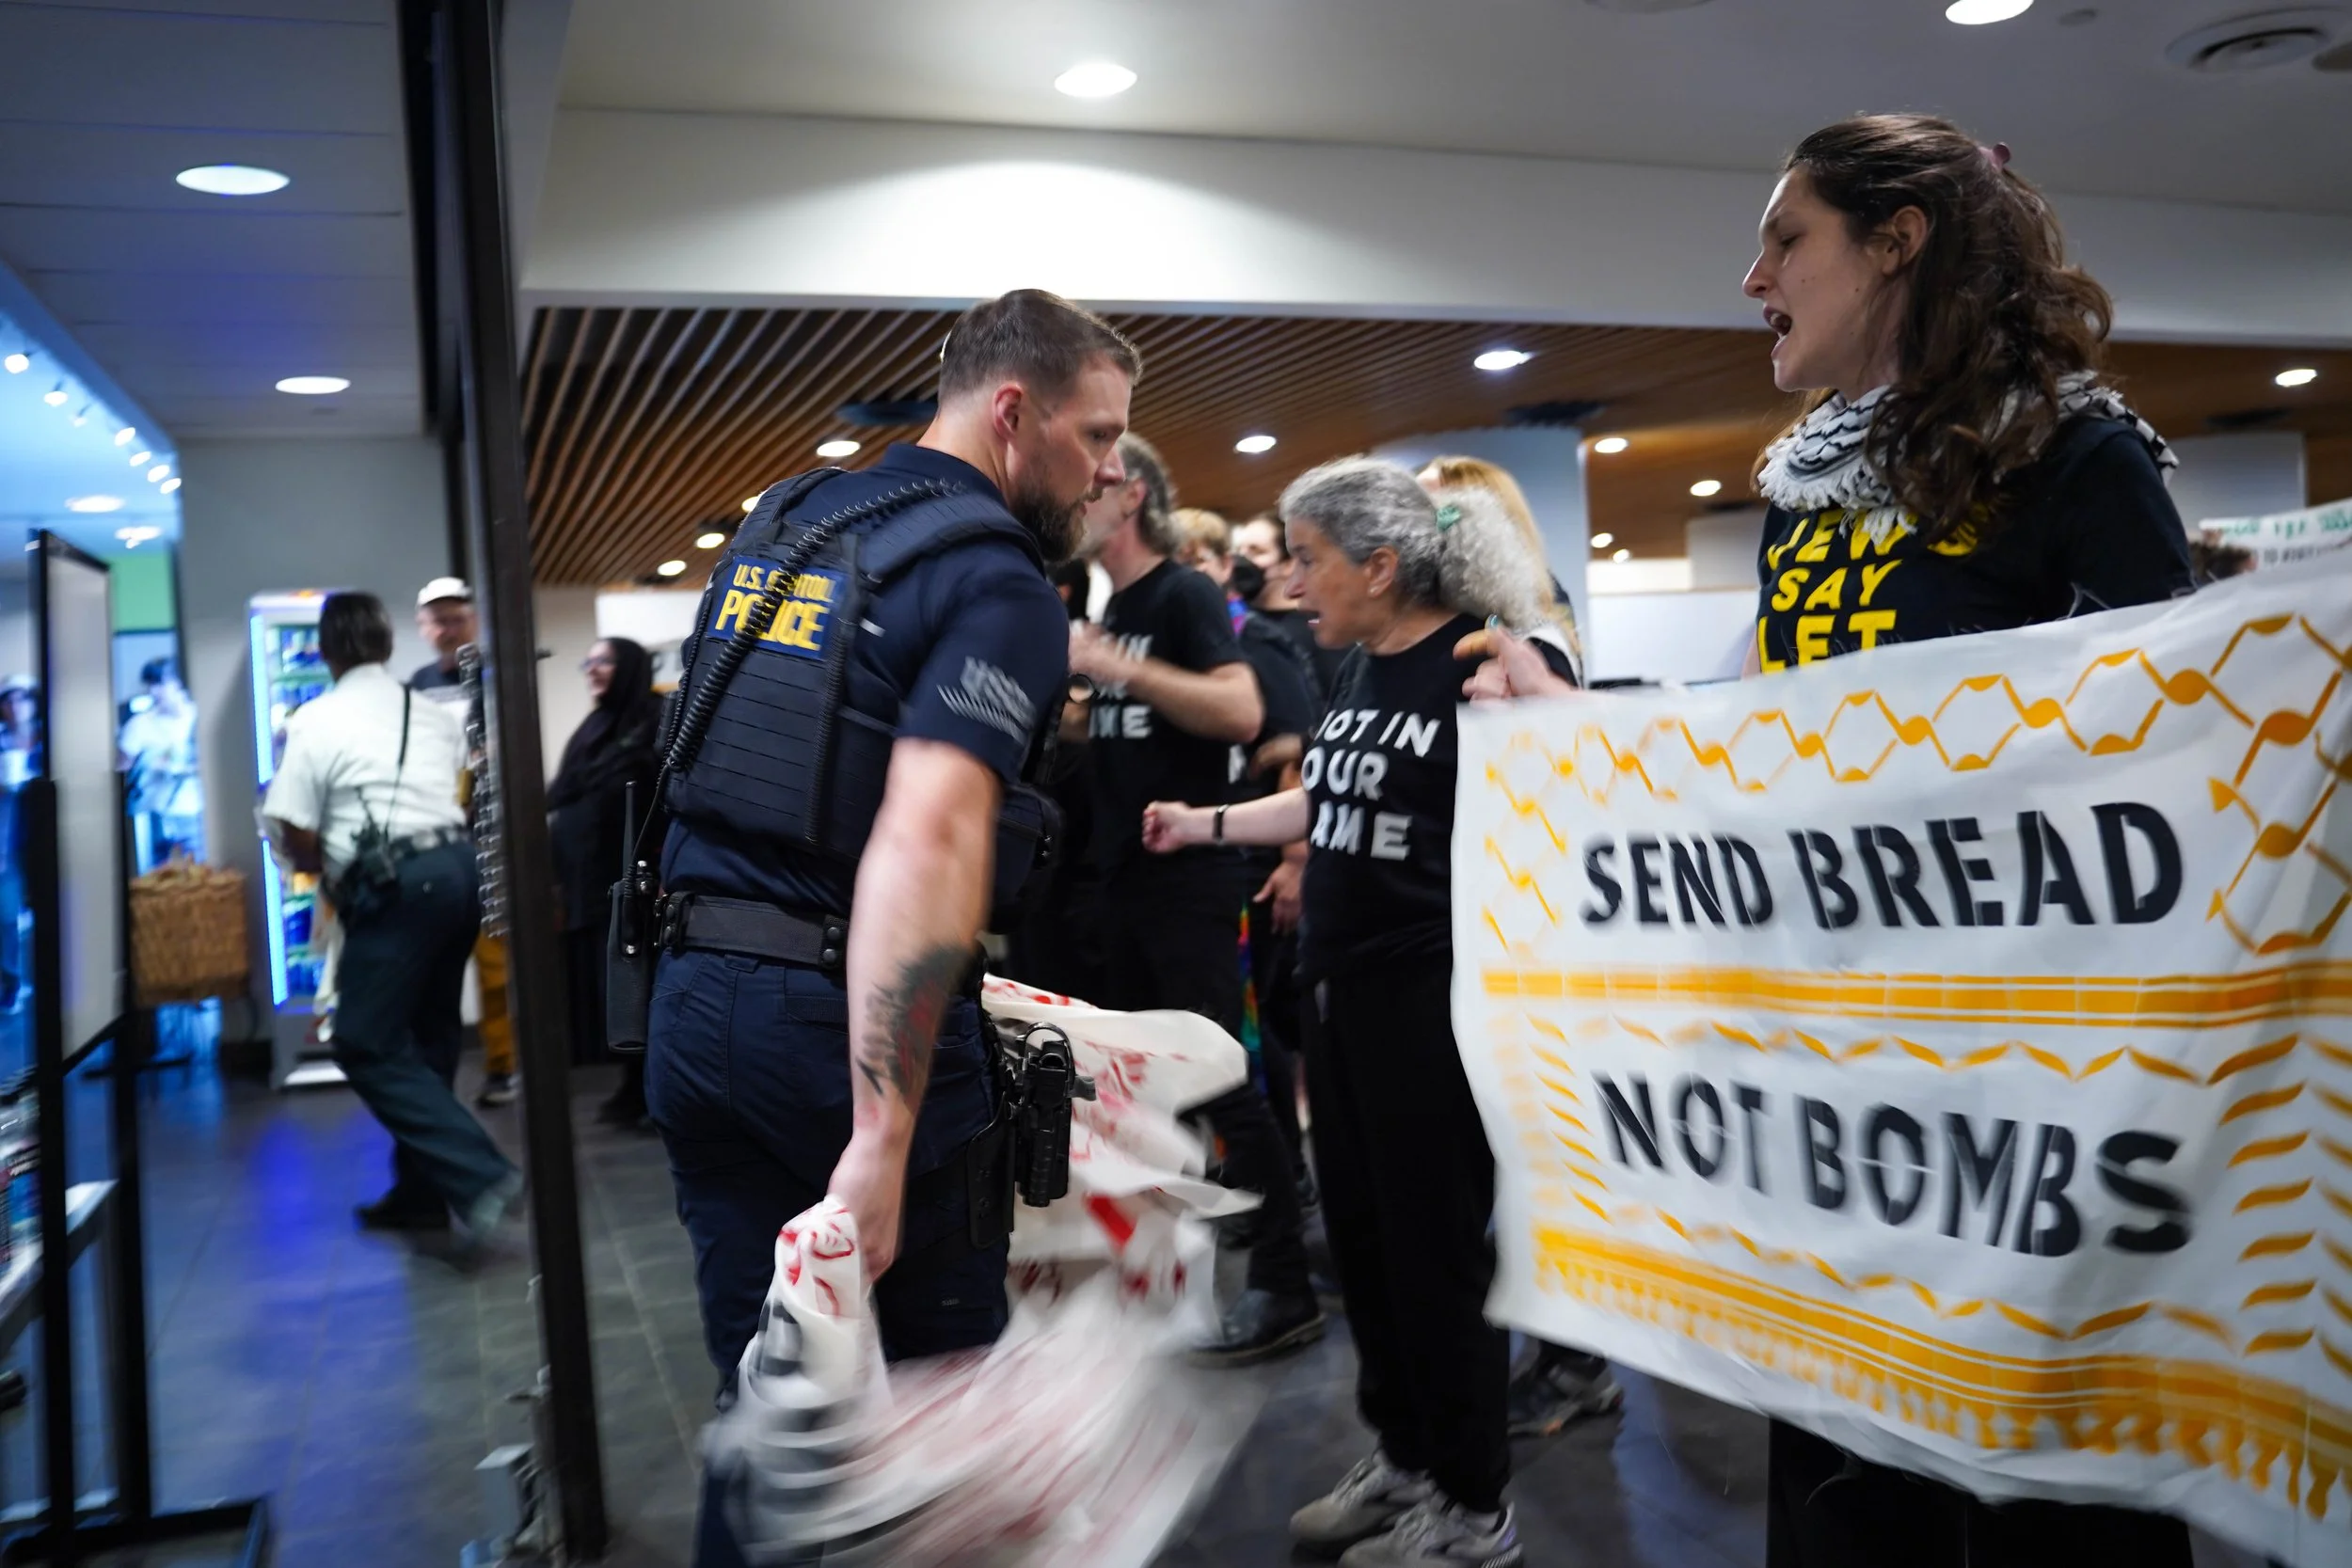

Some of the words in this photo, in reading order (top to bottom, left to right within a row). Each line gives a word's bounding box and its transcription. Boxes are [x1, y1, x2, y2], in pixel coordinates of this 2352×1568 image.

[733, 563, 765, 592] U.S.
[1771, 560, 1902, 611] SAY
[1757, 610, 1897, 674] LET
[1377, 711, 1441, 758] IN
[1301, 746, 1389, 801] OUR
[1311, 800, 1413, 861] AME
[1578, 830, 1775, 931] SEND
[1787, 801, 2184, 931] BREAD
[1591, 1071, 1773, 1196] NOT
[1792, 1097, 2193, 1259] BOMBS
